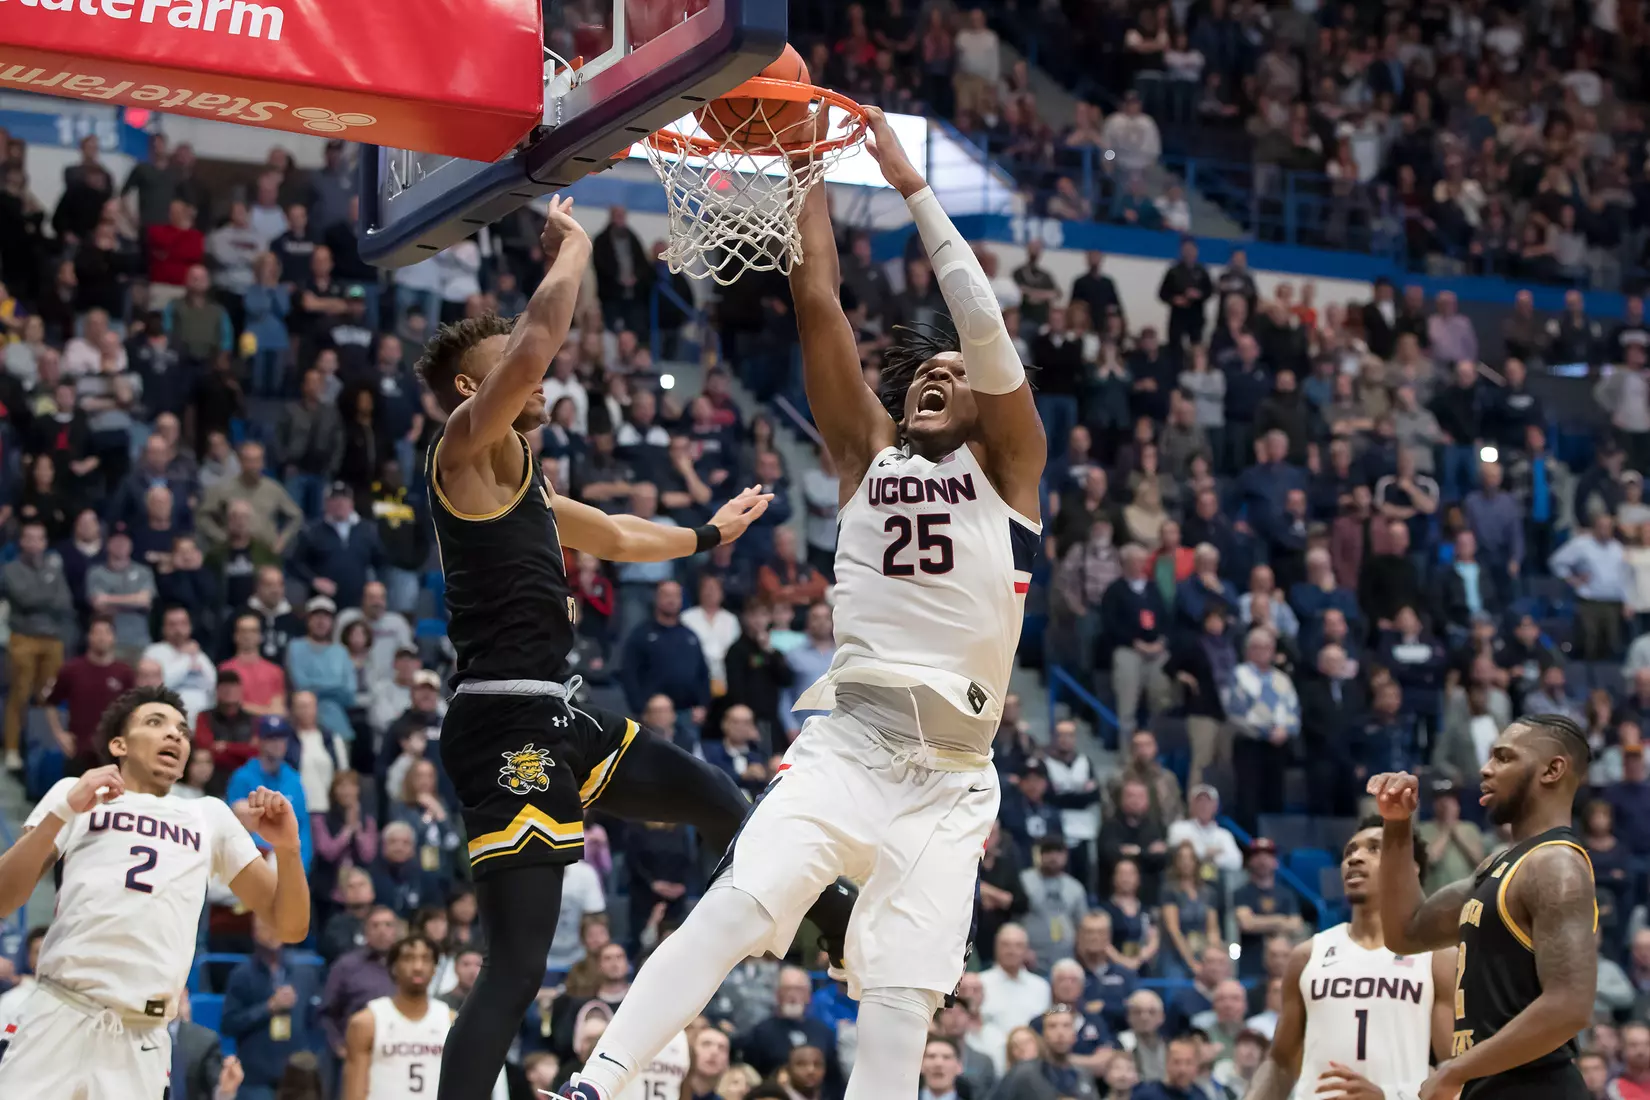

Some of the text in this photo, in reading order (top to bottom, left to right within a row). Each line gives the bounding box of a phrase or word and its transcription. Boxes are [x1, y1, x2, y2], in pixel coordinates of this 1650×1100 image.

[868, 473, 977, 506] UCONN
[882, 512, 954, 576] 25
[89, 811, 200, 852] UCONN
[124, 845, 158, 894] 2
[1310, 976, 1424, 1005] UCONN
[1355, 1009, 1369, 1061] 1
[408, 1062, 424, 1093] 5
